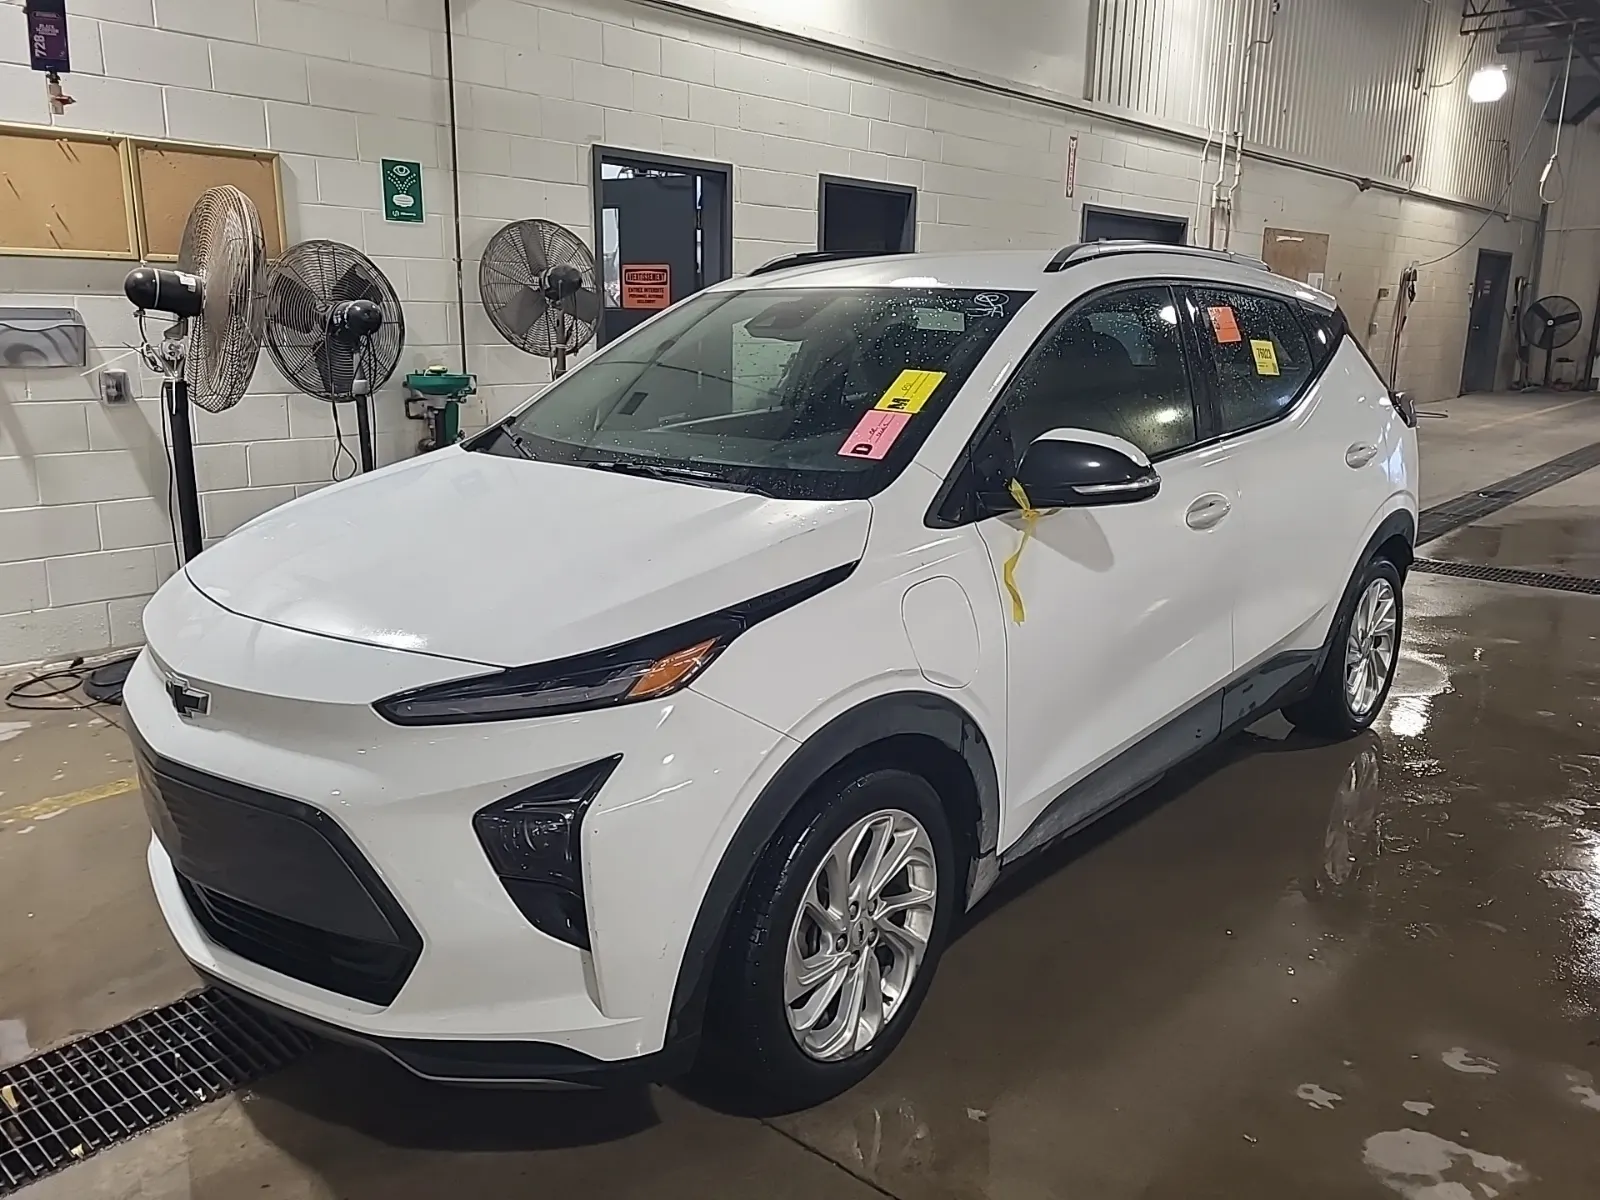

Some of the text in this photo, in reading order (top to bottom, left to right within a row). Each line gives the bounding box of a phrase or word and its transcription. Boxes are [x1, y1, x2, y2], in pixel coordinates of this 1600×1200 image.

[34, 34, 47, 57] 728
[627, 272, 665, 281] AVERTISSEMENT
[887, 397, 910, 411] M
[851, 442, 873, 456] D
